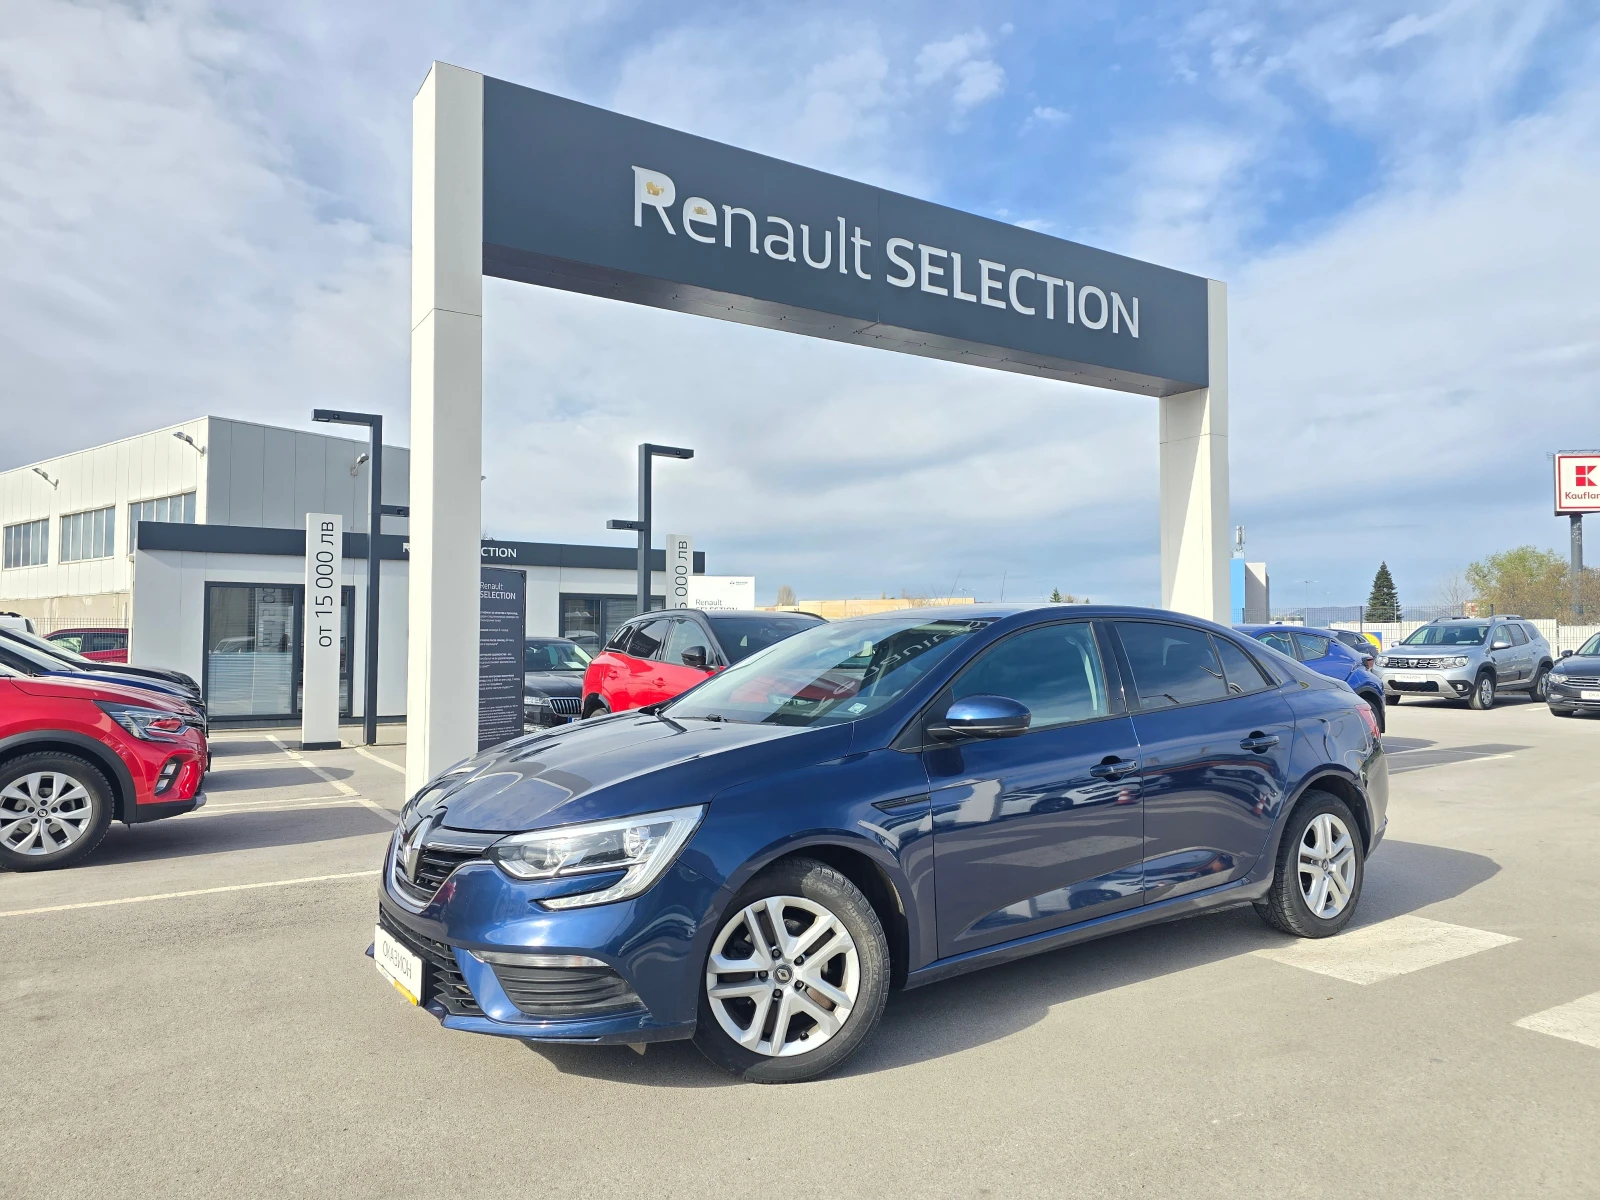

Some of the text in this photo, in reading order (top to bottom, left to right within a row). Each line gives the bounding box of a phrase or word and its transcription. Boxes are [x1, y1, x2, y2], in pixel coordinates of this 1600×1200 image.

[631, 165, 1140, 339] Renault SELECTION
[480, 547, 517, 558] CTION
[315, 551, 334, 589] 000
[674, 565, 688, 597] 000
[480, 582, 504, 591] Renault
[480, 591, 516, 600] SELECTION
[315, 595, 333, 618] 15
[695, 598, 722, 606] Renault
[382, 940, 412, 980] ОКАЗИОН
